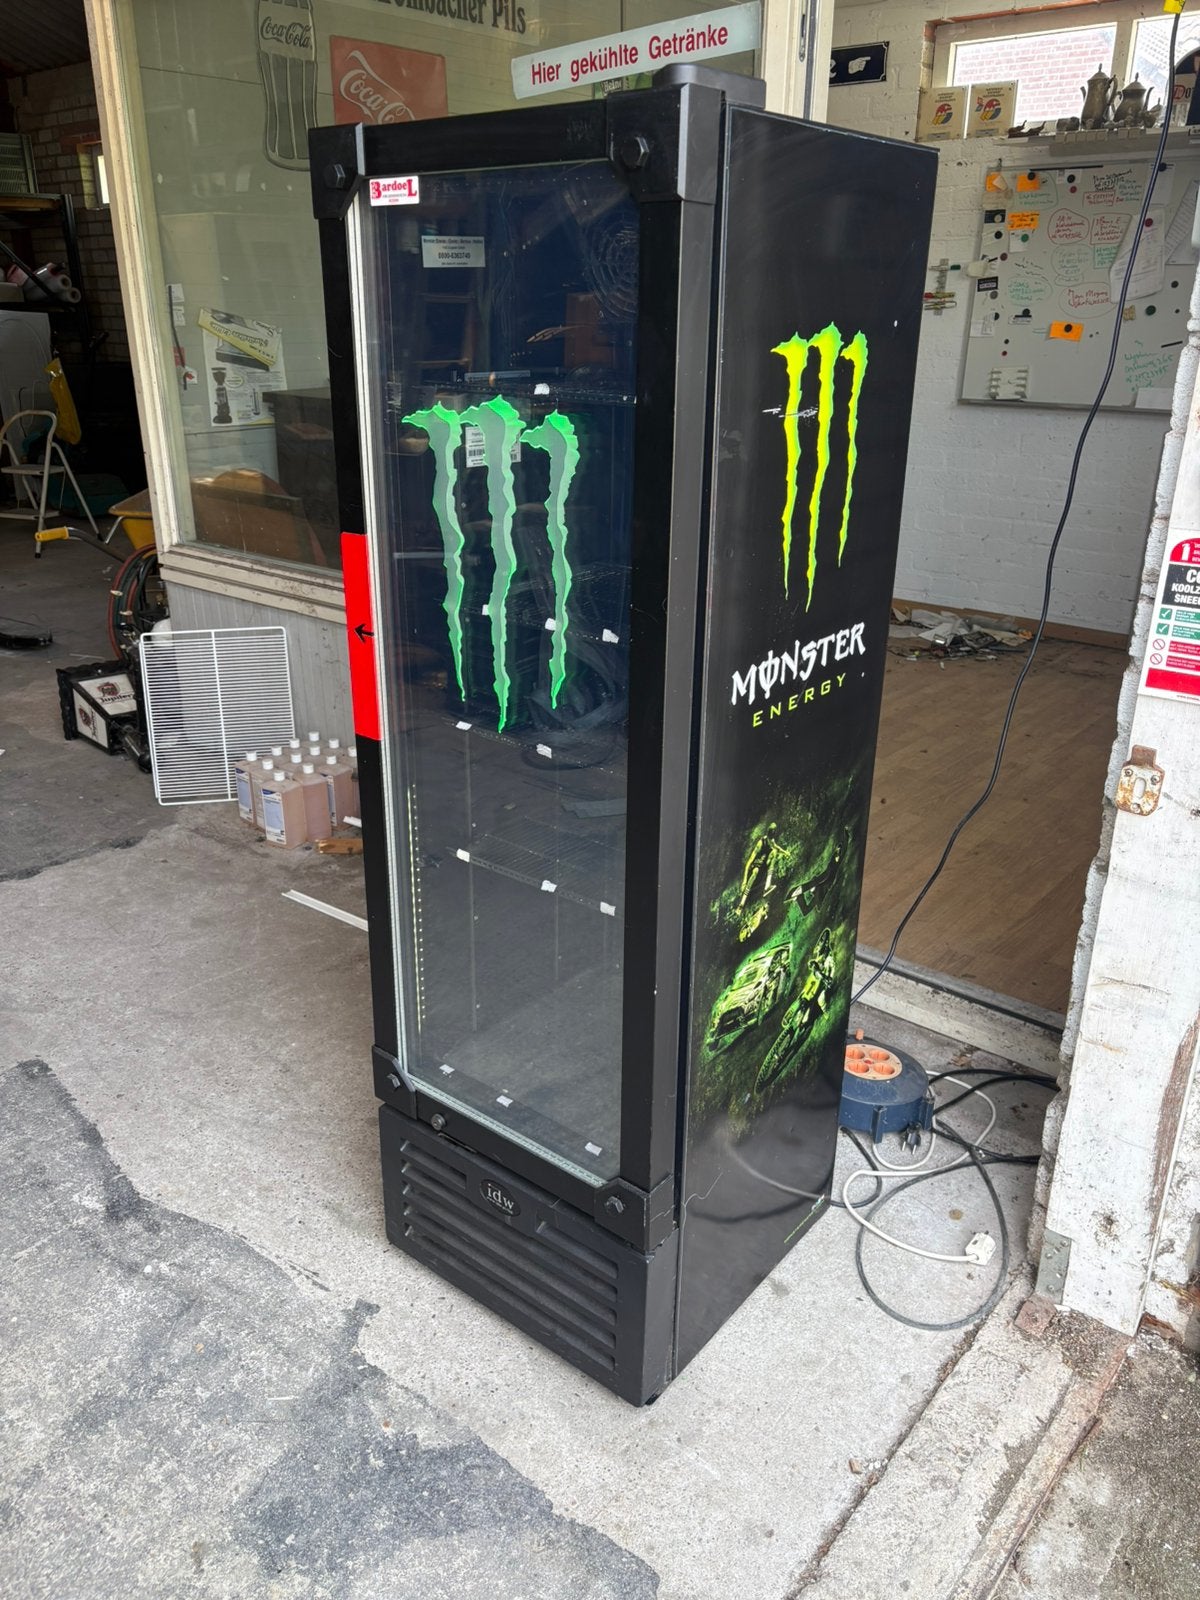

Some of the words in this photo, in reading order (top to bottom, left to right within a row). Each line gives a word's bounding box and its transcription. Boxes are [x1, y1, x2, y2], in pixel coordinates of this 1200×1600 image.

[491, 0, 527, 34] Pils
[531, 61, 562, 86] Hier
[570, 43, 639, 82] gekühlte
[648, 24, 729, 60] Getränke
[751, 672, 847, 729] ENERGY
[487, 1182, 515, 1210] idw
